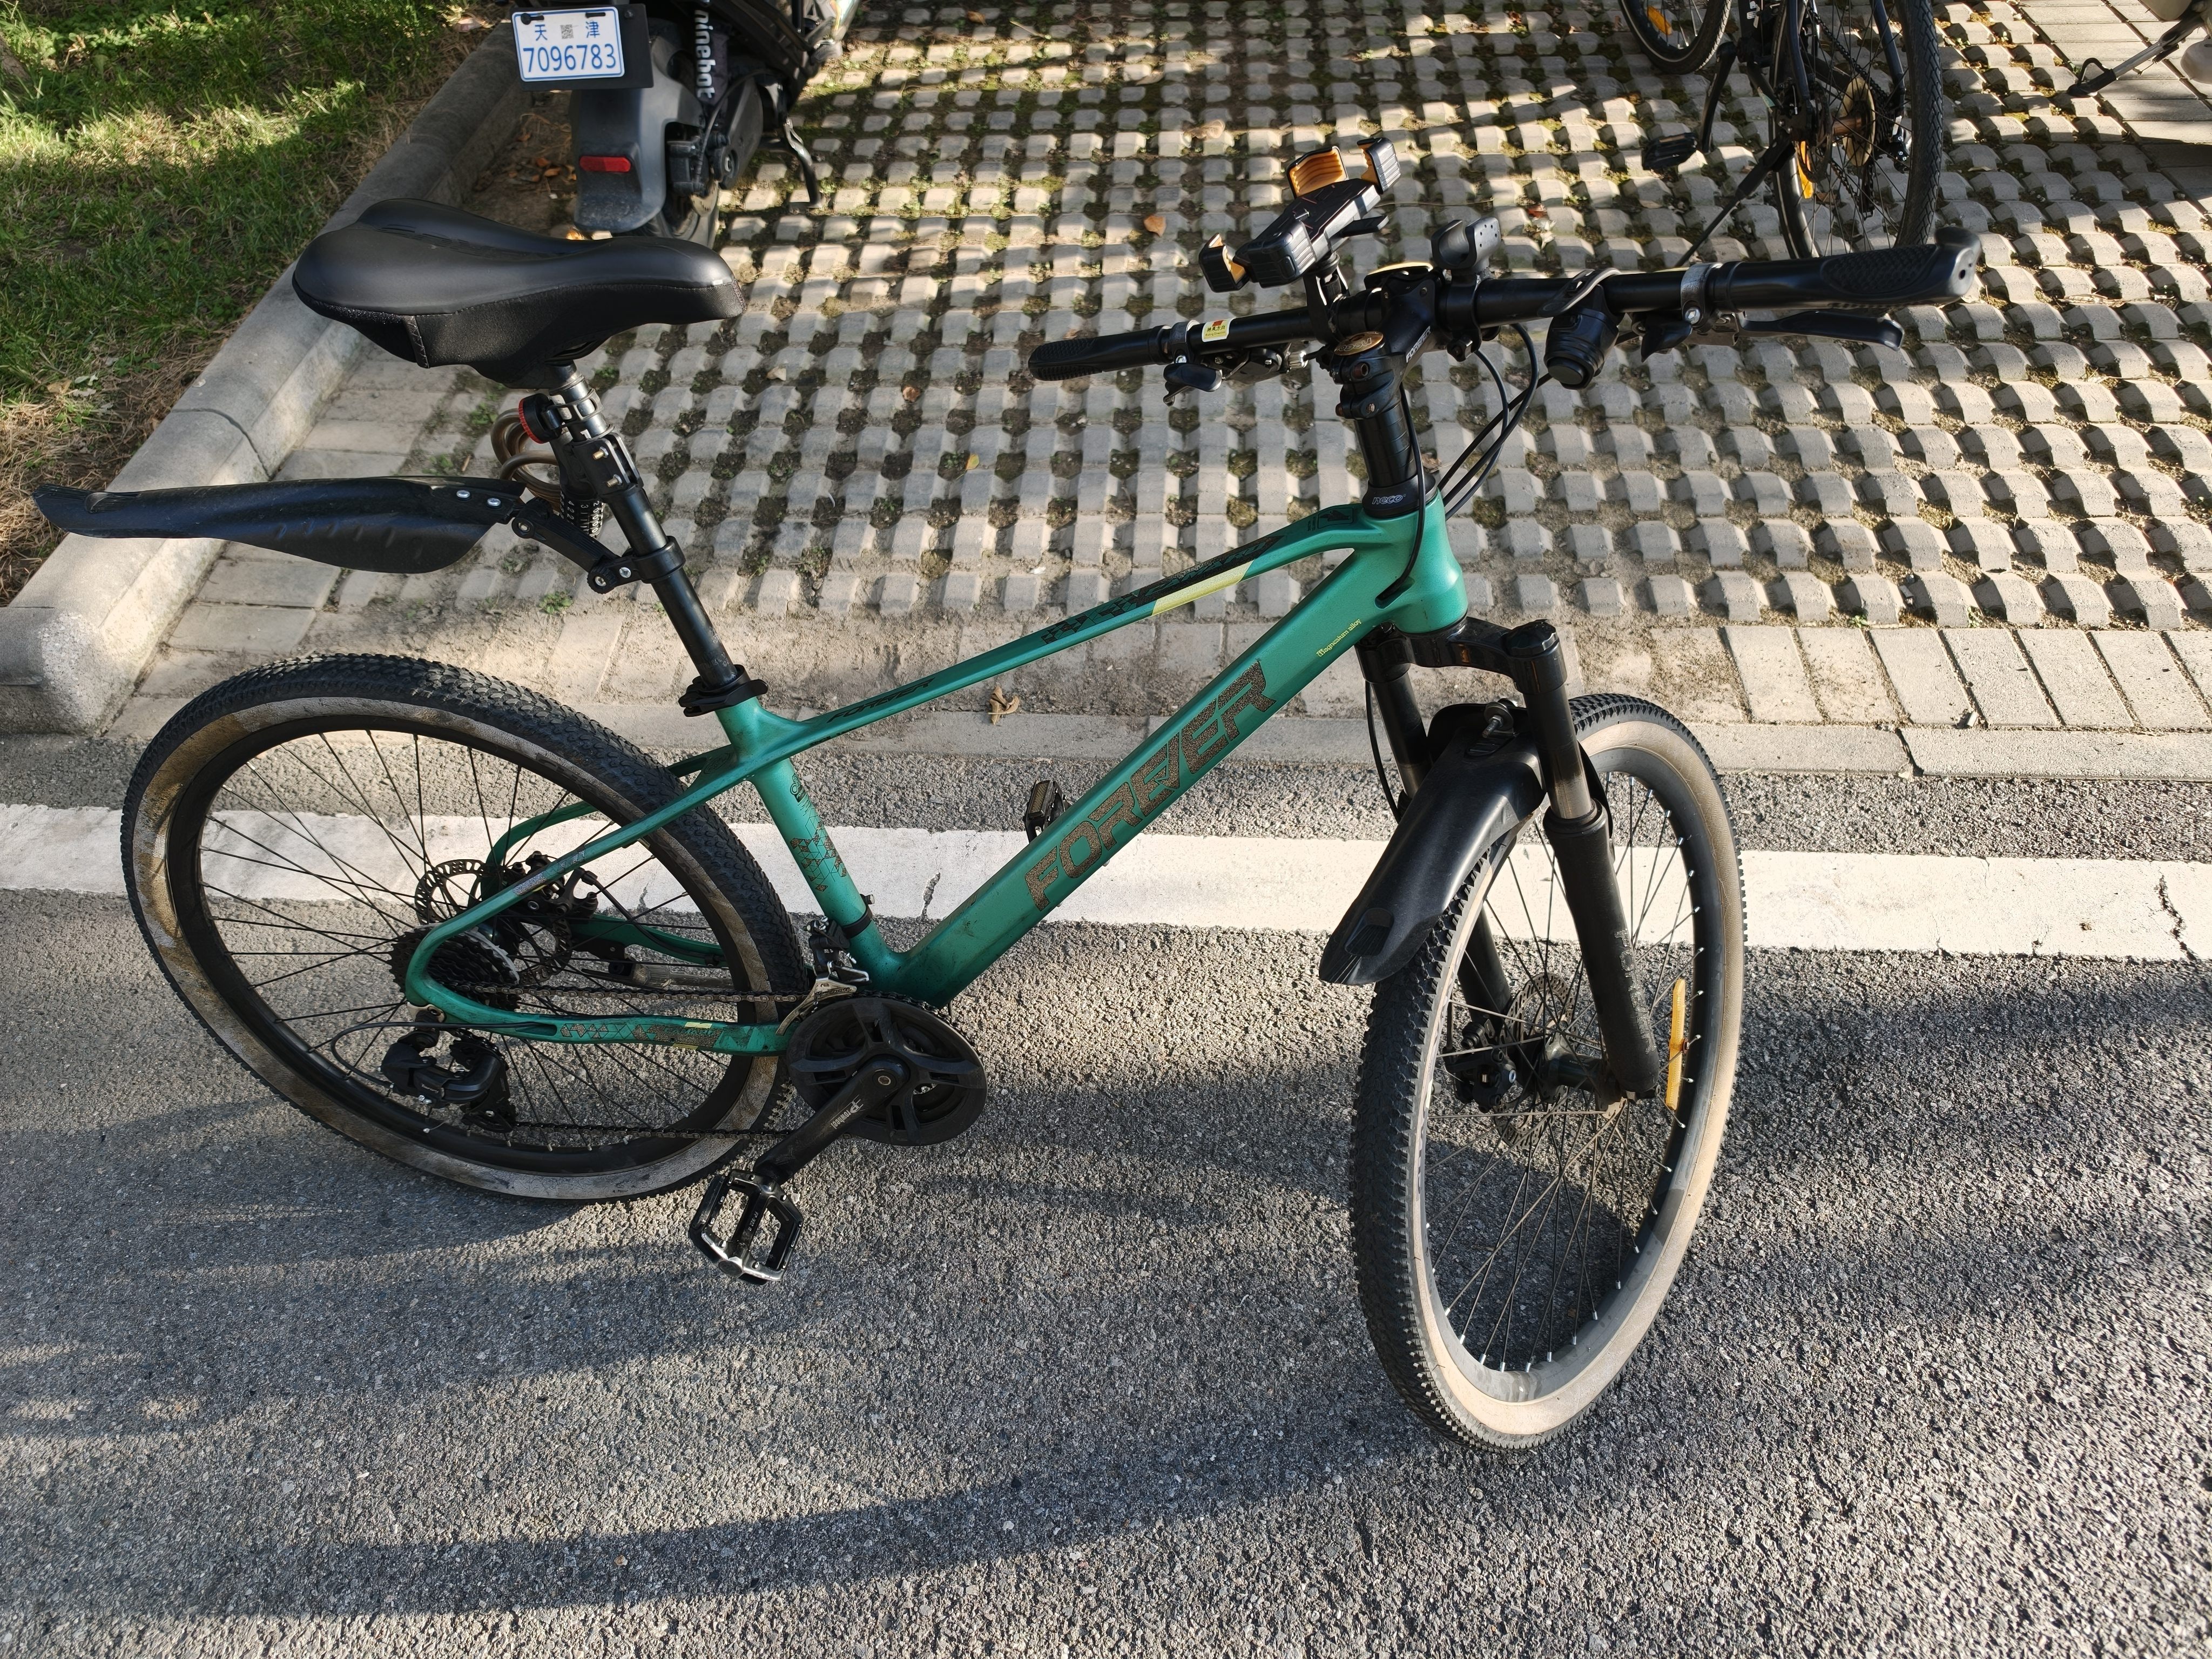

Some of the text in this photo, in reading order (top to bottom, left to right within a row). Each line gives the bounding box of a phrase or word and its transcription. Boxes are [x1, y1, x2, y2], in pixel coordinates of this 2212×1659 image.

[535, 21, 601, 41] 天 津
[523, 43, 616, 72] 7096783
[694, 9, 716, 98] ninebot
[1372, 494, 1403, 505] neco
[1316, 618, 1361, 657] Magnesium alloy
[1025, 659, 1277, 912] FOREVER
[831, 1098, 863, 1129] Prowheel
